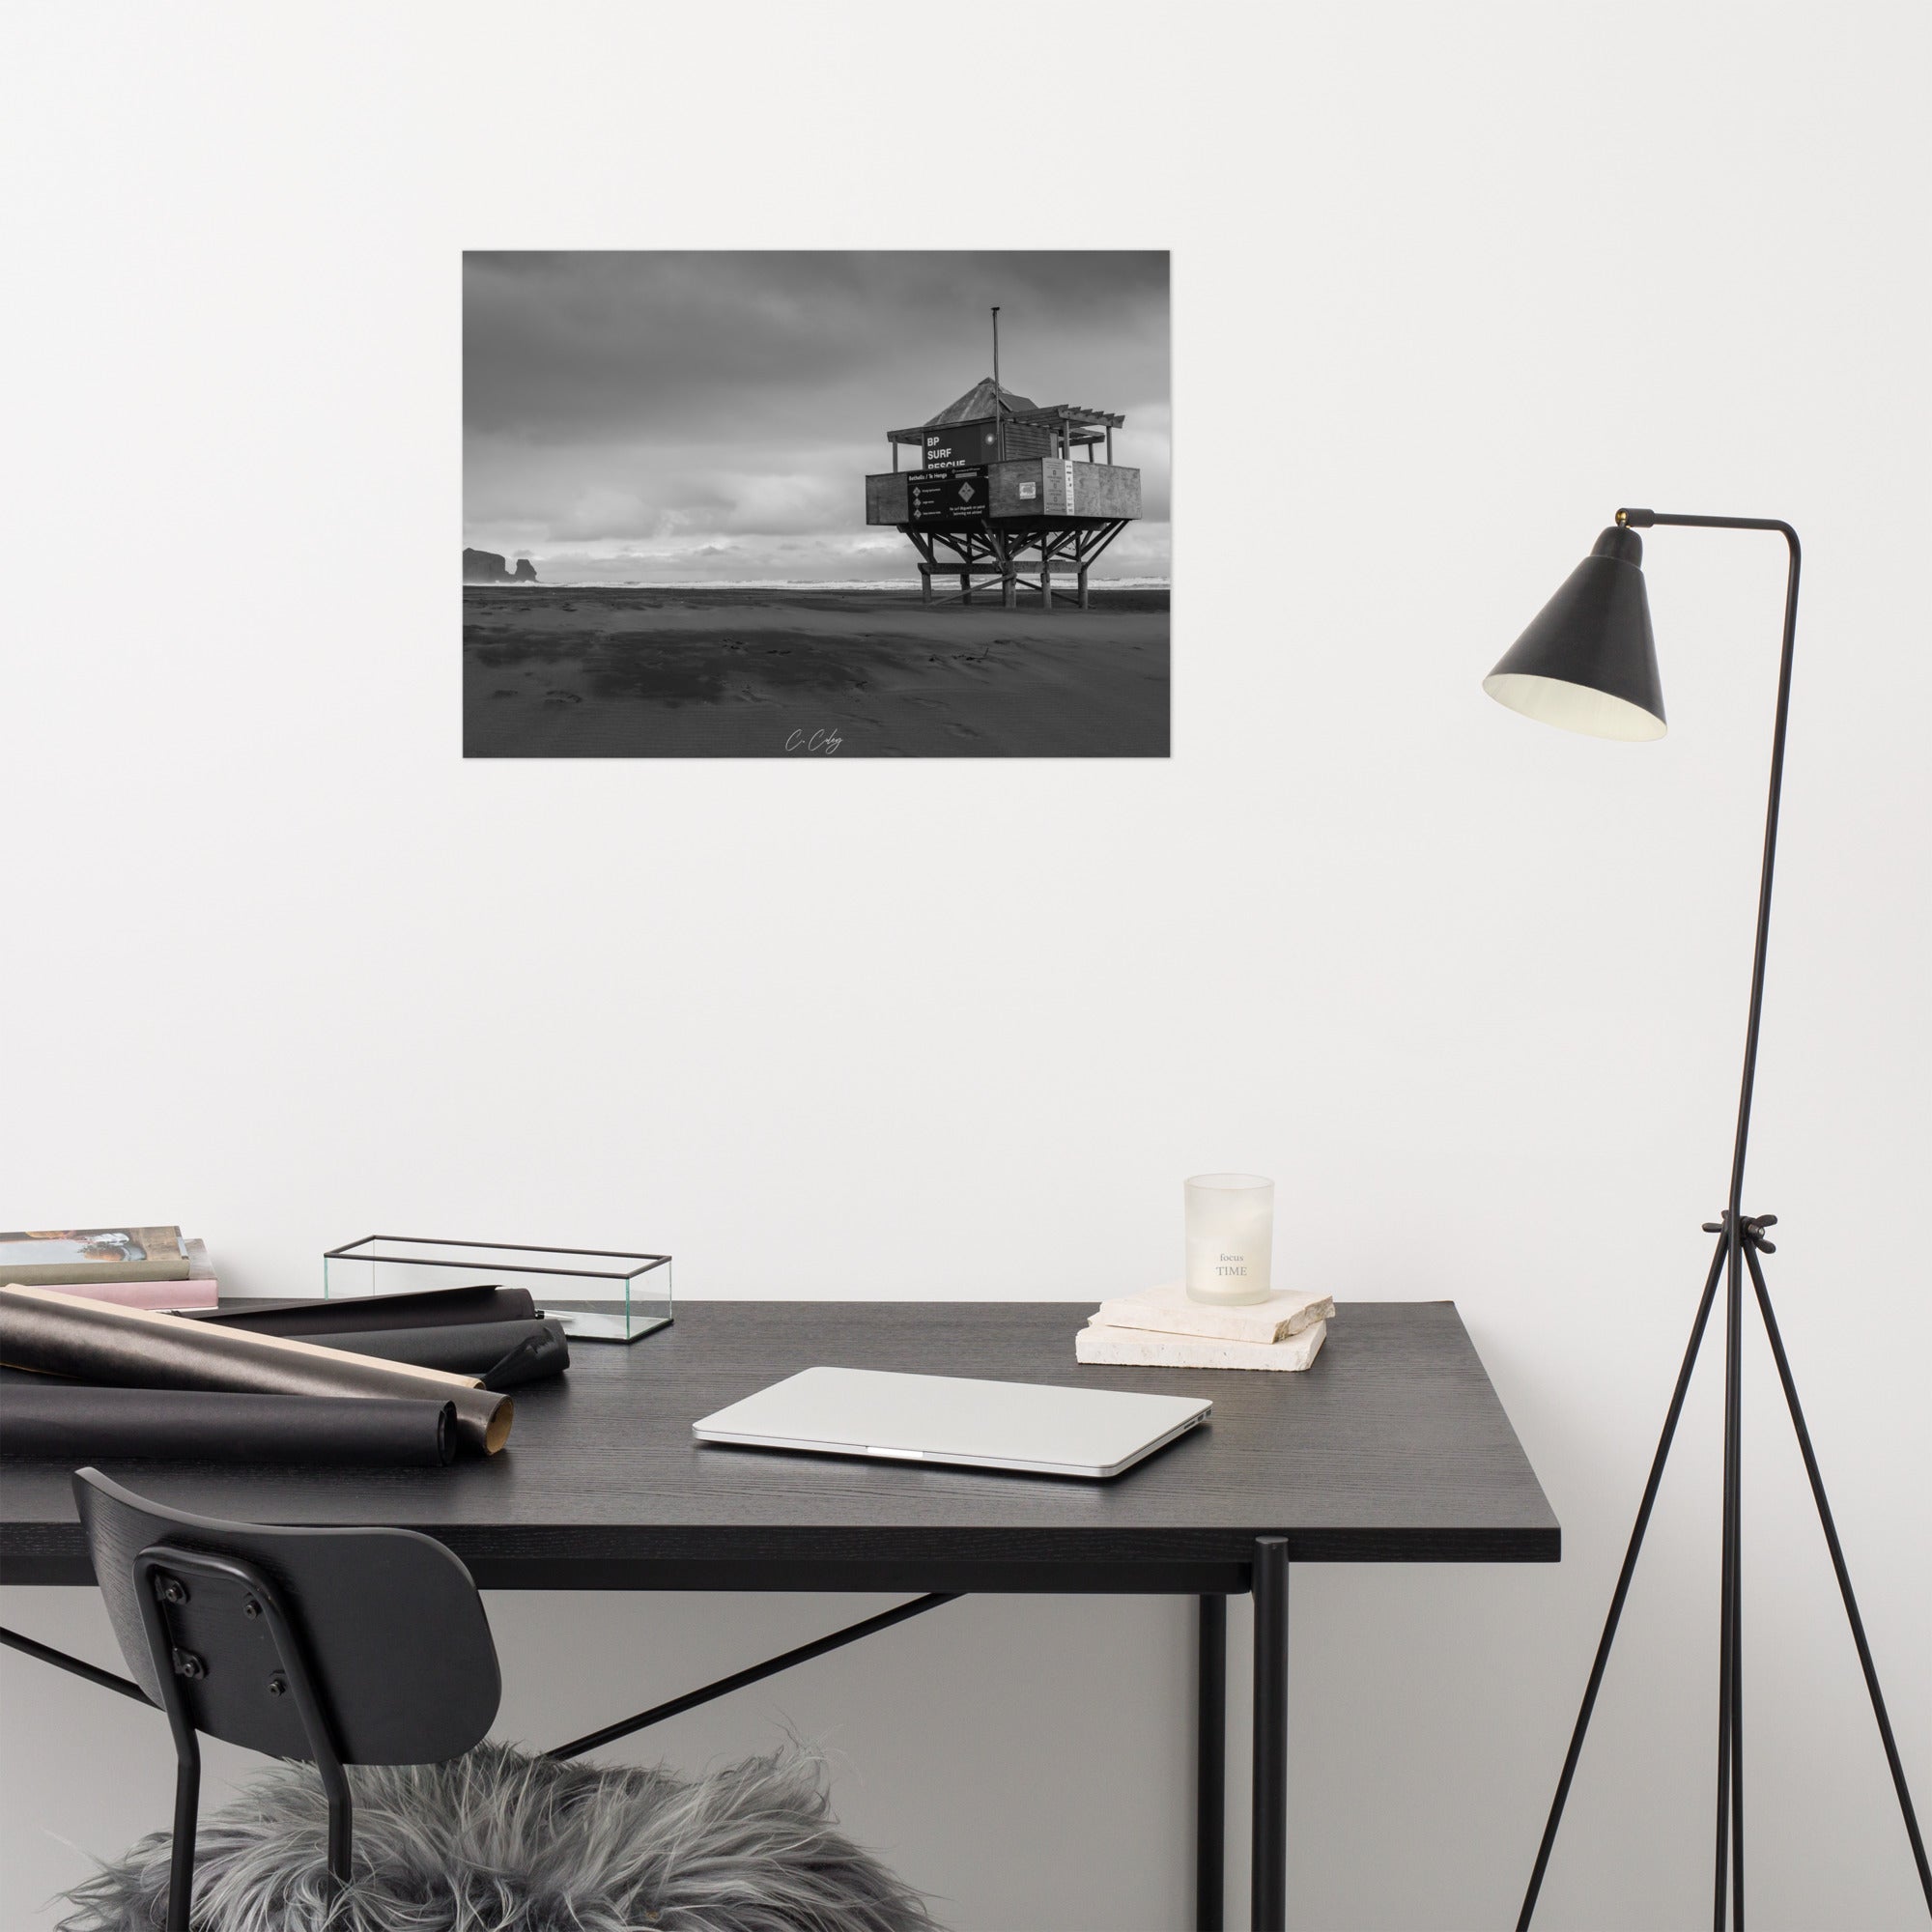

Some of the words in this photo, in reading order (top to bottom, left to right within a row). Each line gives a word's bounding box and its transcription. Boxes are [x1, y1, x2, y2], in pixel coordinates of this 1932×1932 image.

[927, 437, 940, 446] BP
[927, 448, 952, 460] SURF
[1215, 1266, 1248, 1276] TIME
